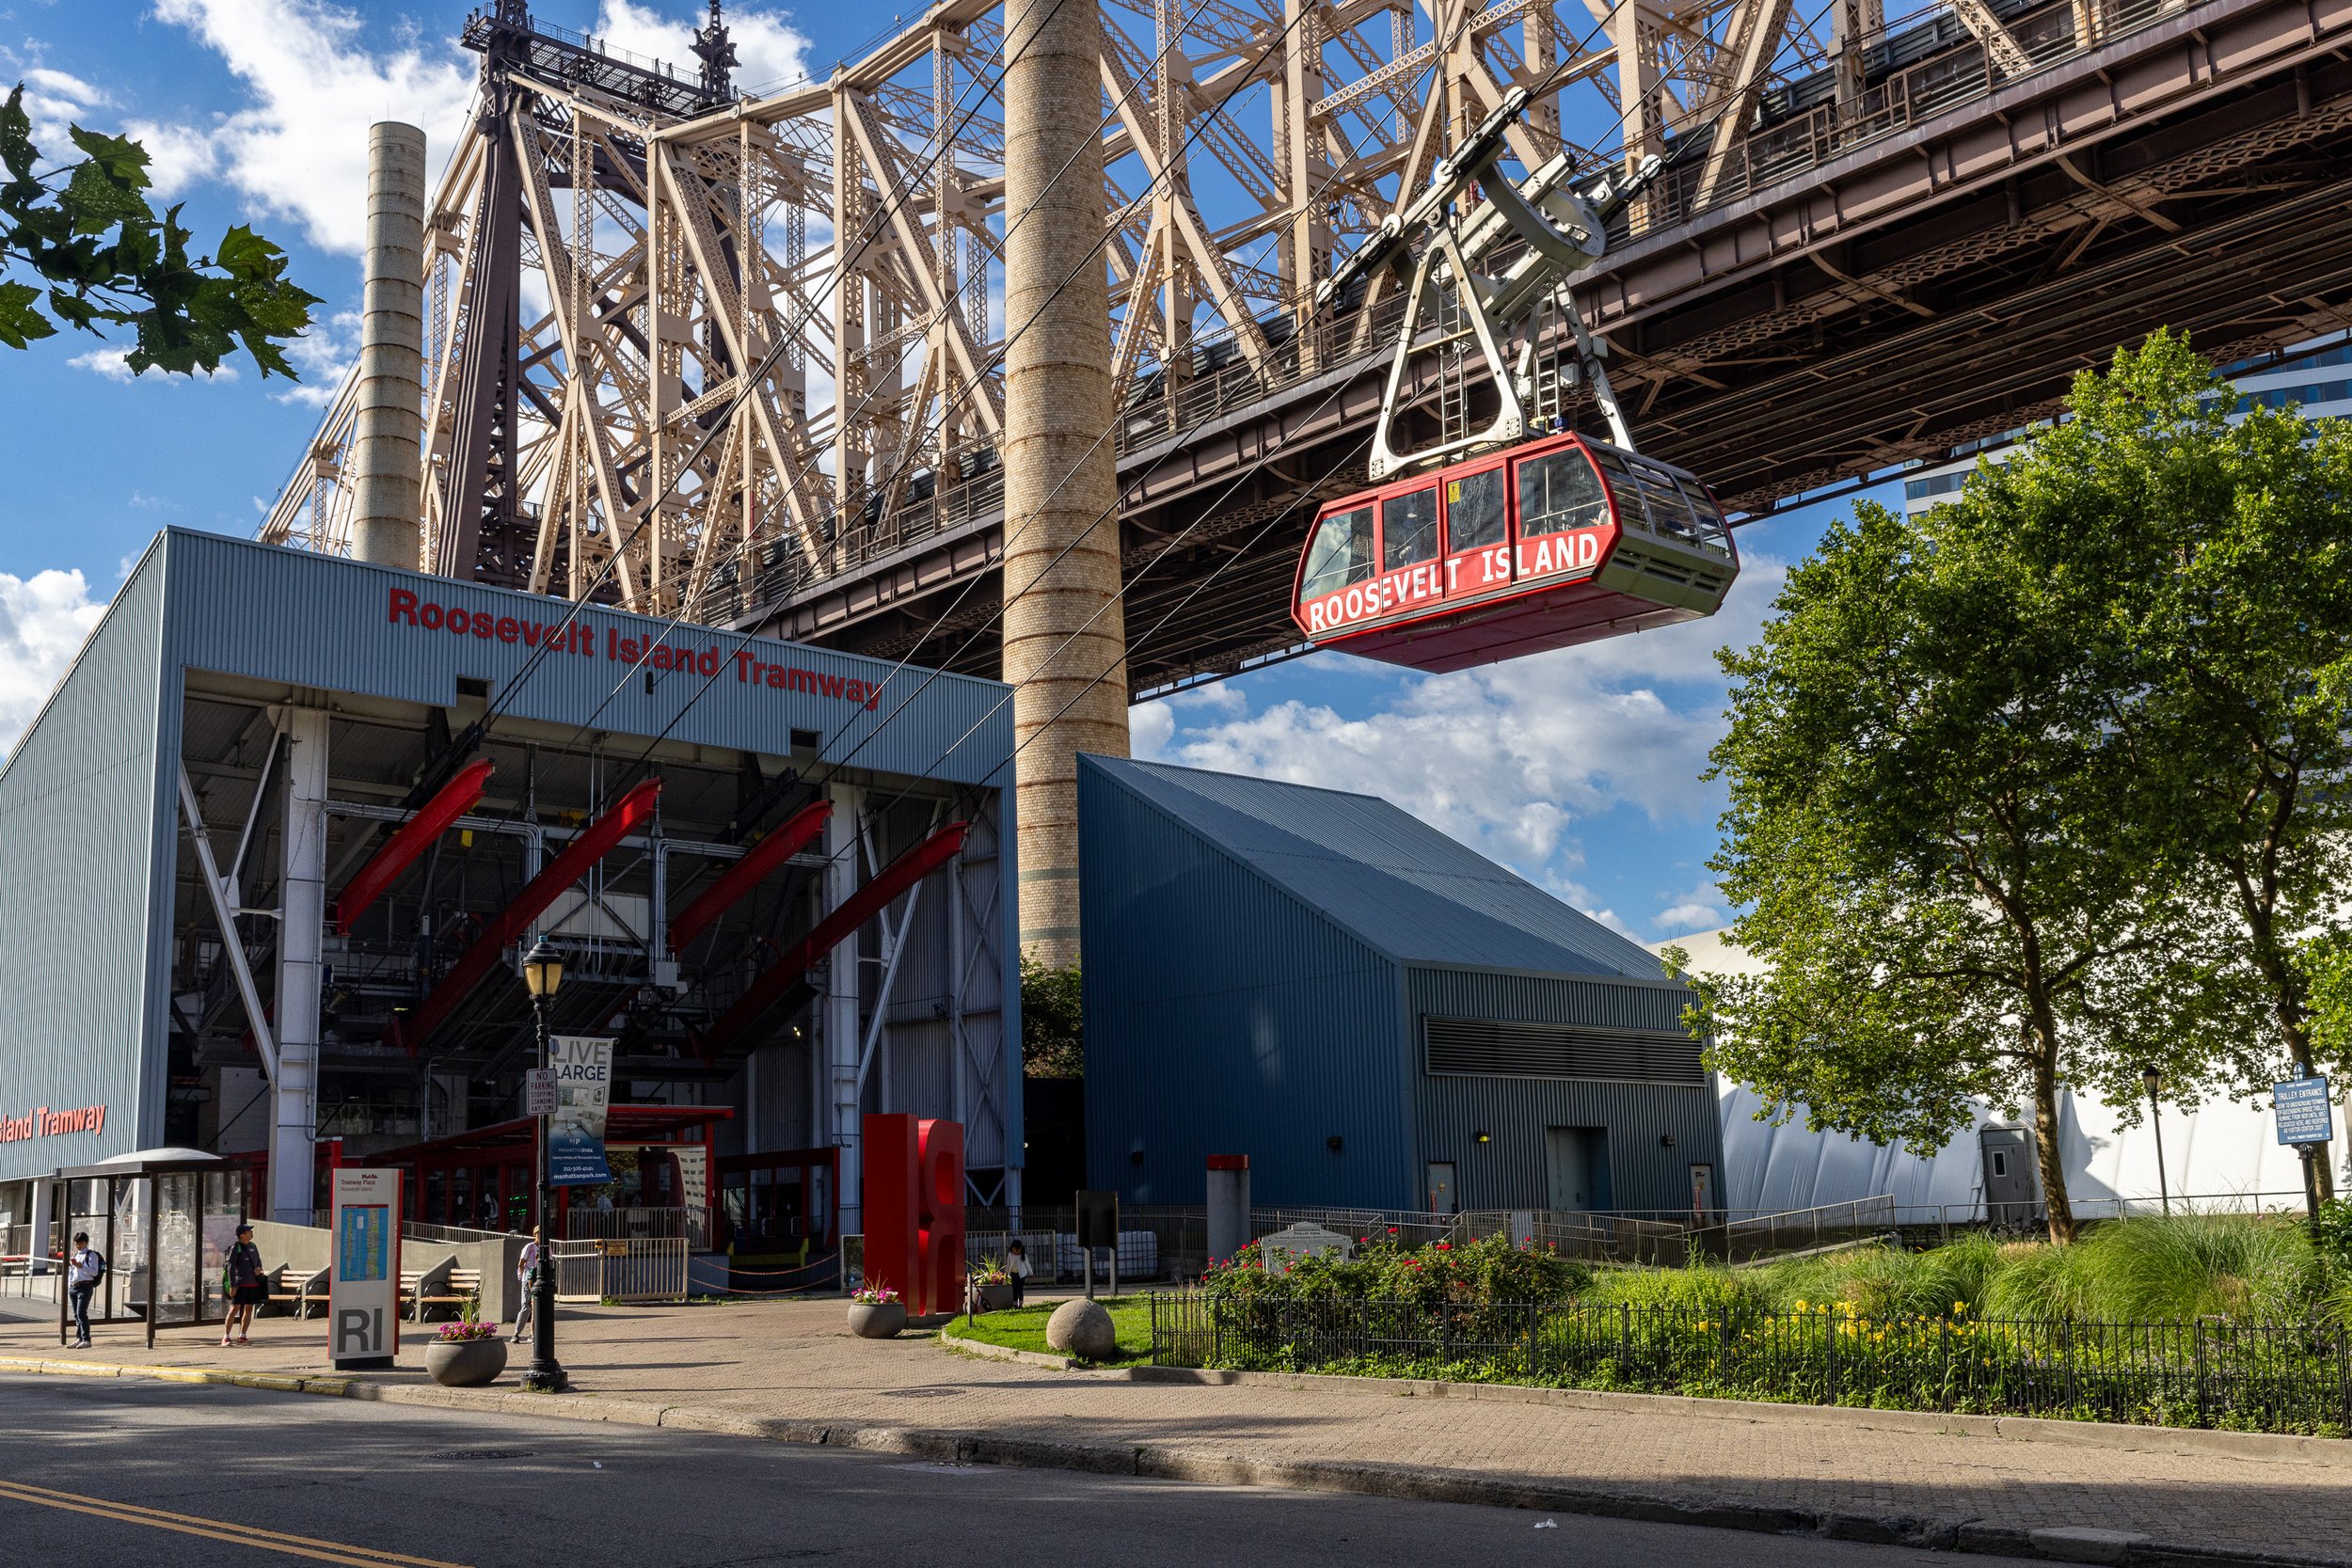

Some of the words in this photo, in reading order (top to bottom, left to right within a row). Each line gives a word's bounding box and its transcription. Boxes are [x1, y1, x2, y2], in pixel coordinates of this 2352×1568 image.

[1310, 557, 1462, 632] ROOSEVELT
[1483, 533, 1598, 582] ISLAND
[389, 587, 595, 657] Roosevelt
[609, 627, 719, 676] Island
[736, 651, 883, 711] Tramway
[553, 1041, 608, 1065] LIVE
[531, 1082, 554, 1090] PARKING
[536, 1071, 548, 1081] NO
[2278, 1090, 2297, 1101] TROLLEY
[2299, 1087, 2323, 1099] ENTRANCE
[0, 1108, 34, 1143] land
[37, 1103, 105, 1136] Tramway
[337, 1308, 383, 1353] RI
